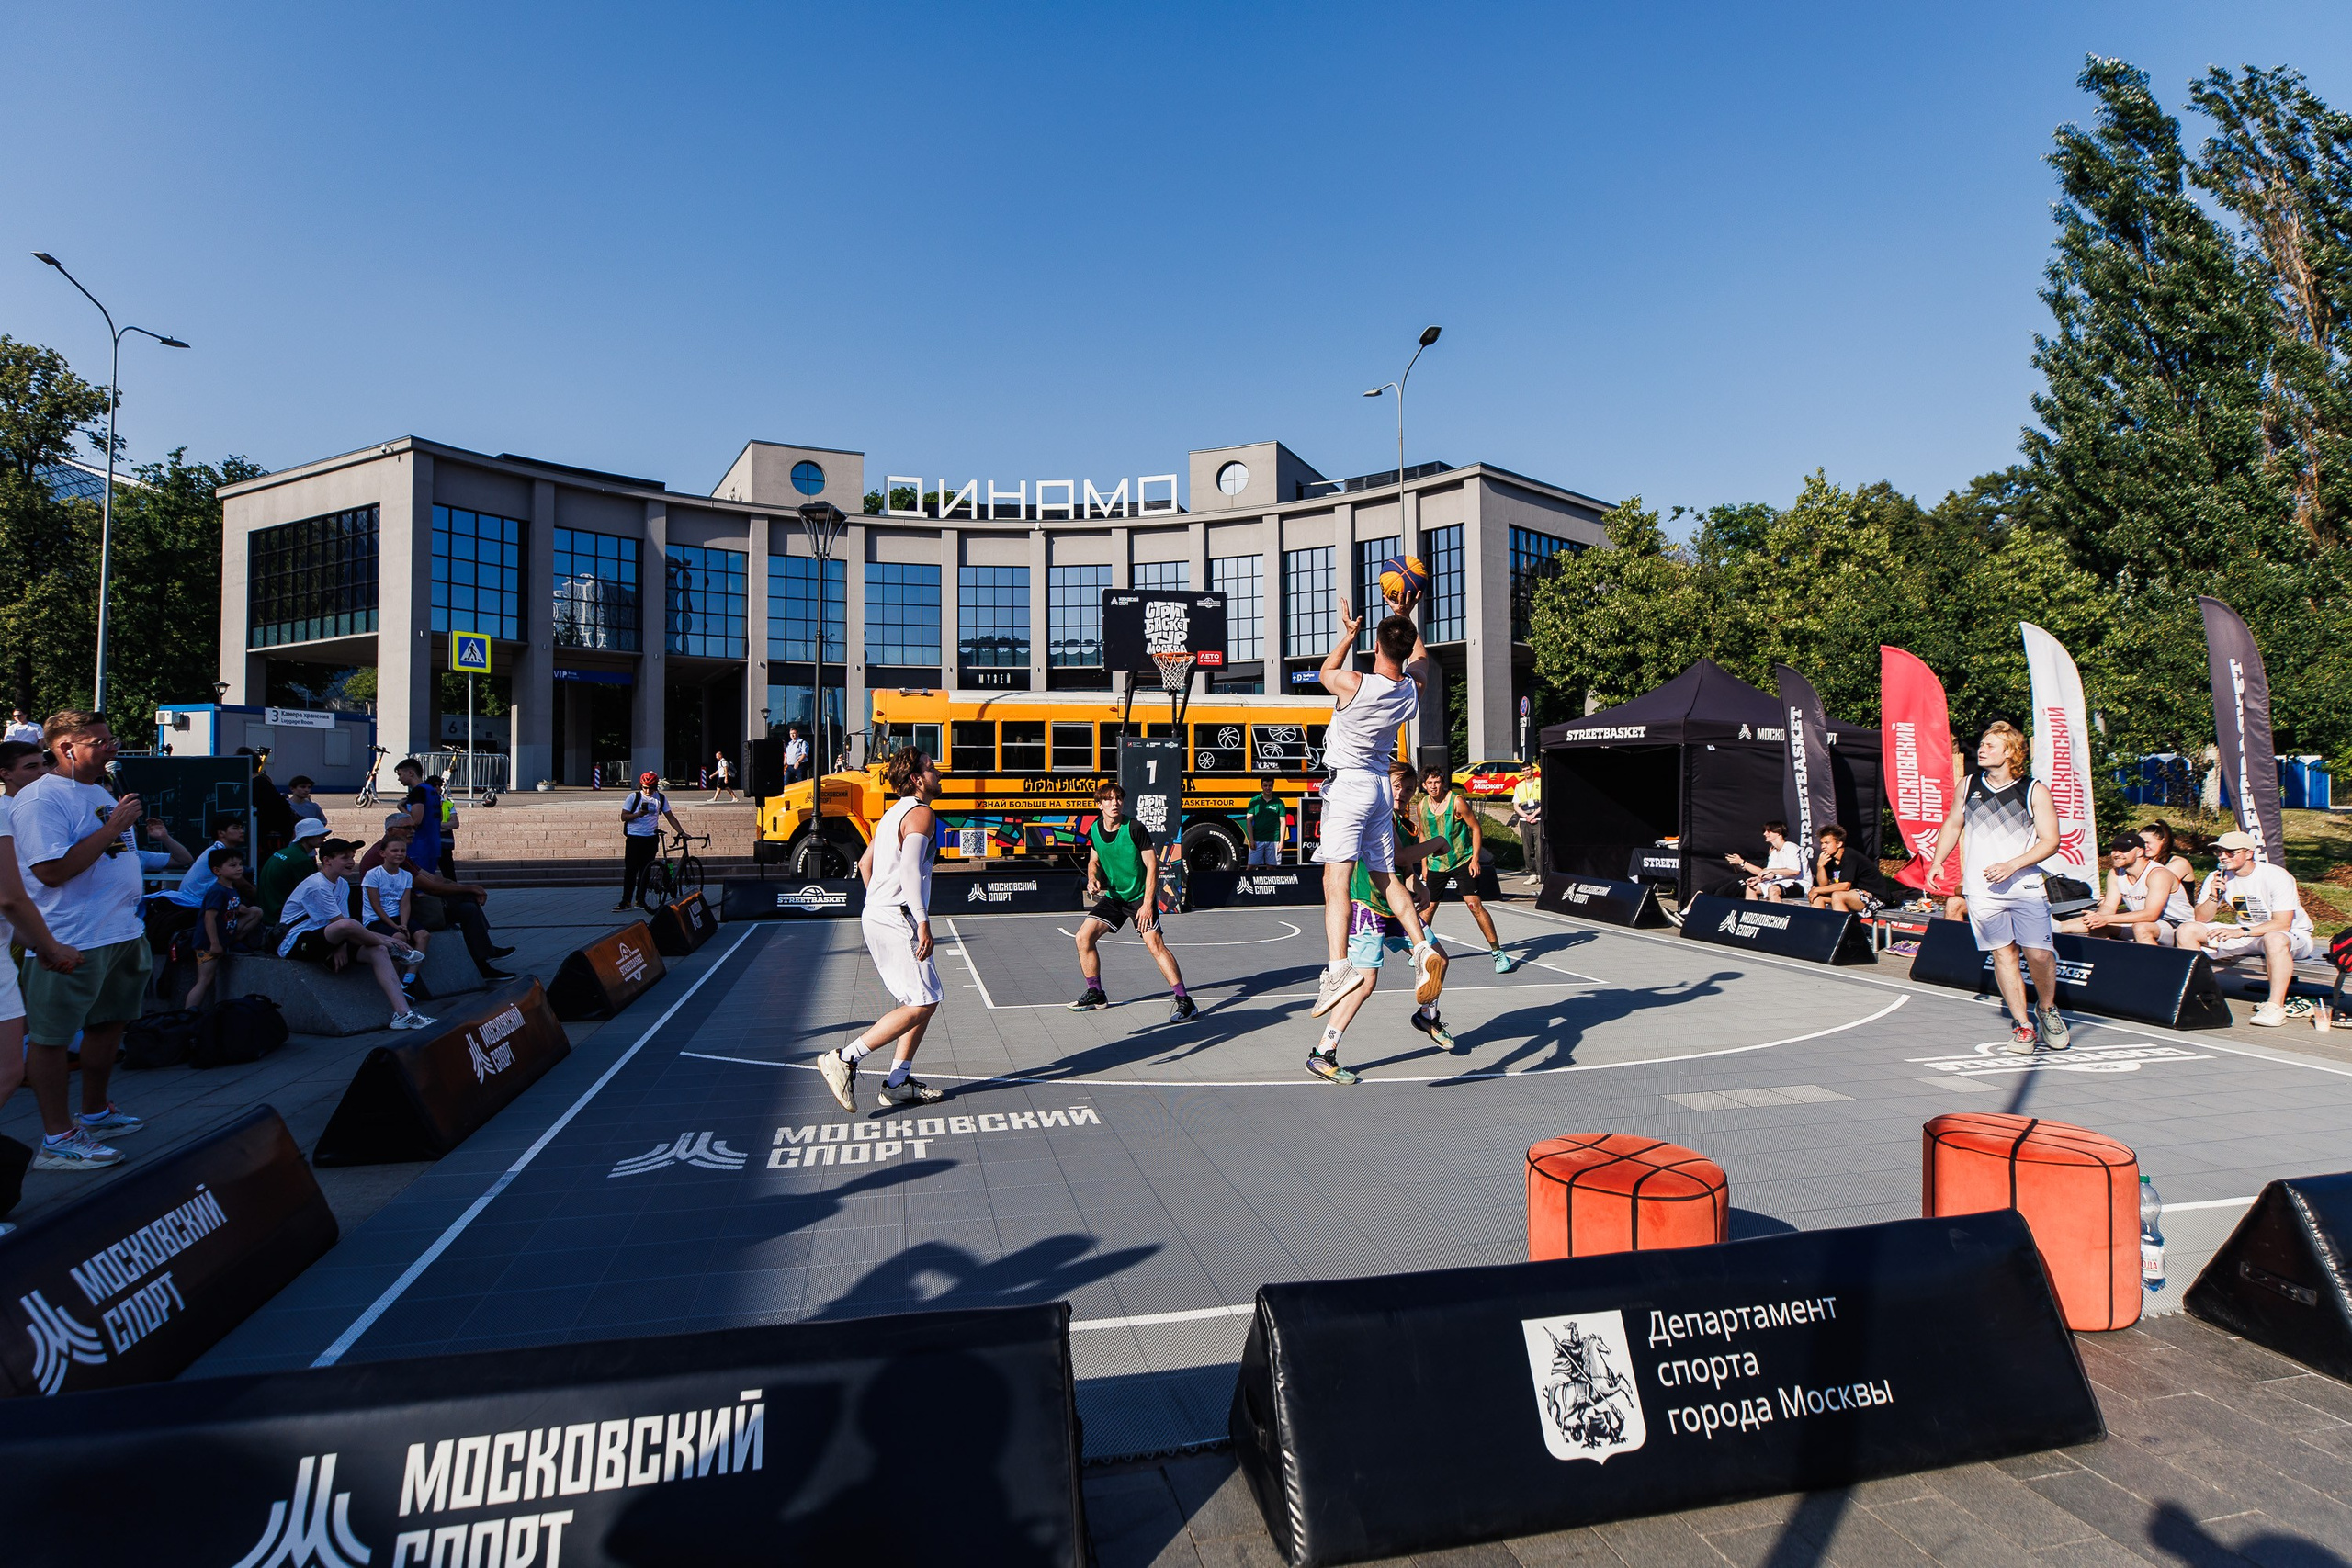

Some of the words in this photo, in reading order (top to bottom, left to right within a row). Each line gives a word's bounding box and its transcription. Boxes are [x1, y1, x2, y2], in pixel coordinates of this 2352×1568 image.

[879, 474, 1178, 520] ДИНАМО
[1145, 601, 1188, 620] СТРИТ
[1144, 617, 1191, 635] БАСКЕТ
[1145, 631, 1188, 645] ТУР
[1146, 643, 1188, 654] МОСКВА
[978, 673, 1011, 683] МУЗЕЙ
[271, 710, 279, 722] 3
[281, 710, 303, 718] Камера
[448, 721, 458, 734] 6
[1566, 726, 1646, 741] STREETBASKET
[1146, 760, 1158, 784] 1
[1892, 722, 1921, 821] МОСКОВСКИЙ
[2042, 707, 2073, 819] МОСКОВСКИЙ
[1791, 706, 1815, 859] STREETBASKET
[977, 800, 1007, 808] УЗНАЙ
[1136, 795, 1167, 807] СТРИТ
[1920, 775, 1944, 823] СПОРТ
[1136, 807, 1168, 818] БАСКЕТ
[1136, 816, 1167, 826] ТУР
[988, 880, 1037, 892] МОСКОВСКИЙ
[1252, 874, 1299, 886] МОСКОВСКИЙ
[988, 892, 1012, 902] СПОРТ
[1254, 885, 1276, 895] СПОРТ
[1573, 893, 1590, 905] СПОРТ
[1577, 883, 1611, 897] МОСКОВСКИЙ
[777, 896, 847, 904] STREETBASKET
[1739, 911, 1792, 931] МОСКОВСКИЙ
[1735, 926, 1760, 939] СПОРТ
[479, 1002, 526, 1048] МОСКОВСКИЙ
[490, 1041, 515, 1073] СПОРТ
[772, 1106, 1101, 1145] МОСКОВСКИЙ
[766, 1139, 933, 1169] СПОРТ
[69, 1183, 229, 1307] МОСКОВСКИЙ
[102, 1270, 186, 1356] СПОРТ
[1648, 1296, 1838, 1348] Департамент
[1657, 1351, 1760, 1390] спорта
[1668, 1396, 1773, 1439] города
[1778, 1379, 1894, 1418] Москвы
[398, 1388, 765, 1517] МОСКОВСКИЙ
[392, 1509, 574, 1568] СПОРТ
